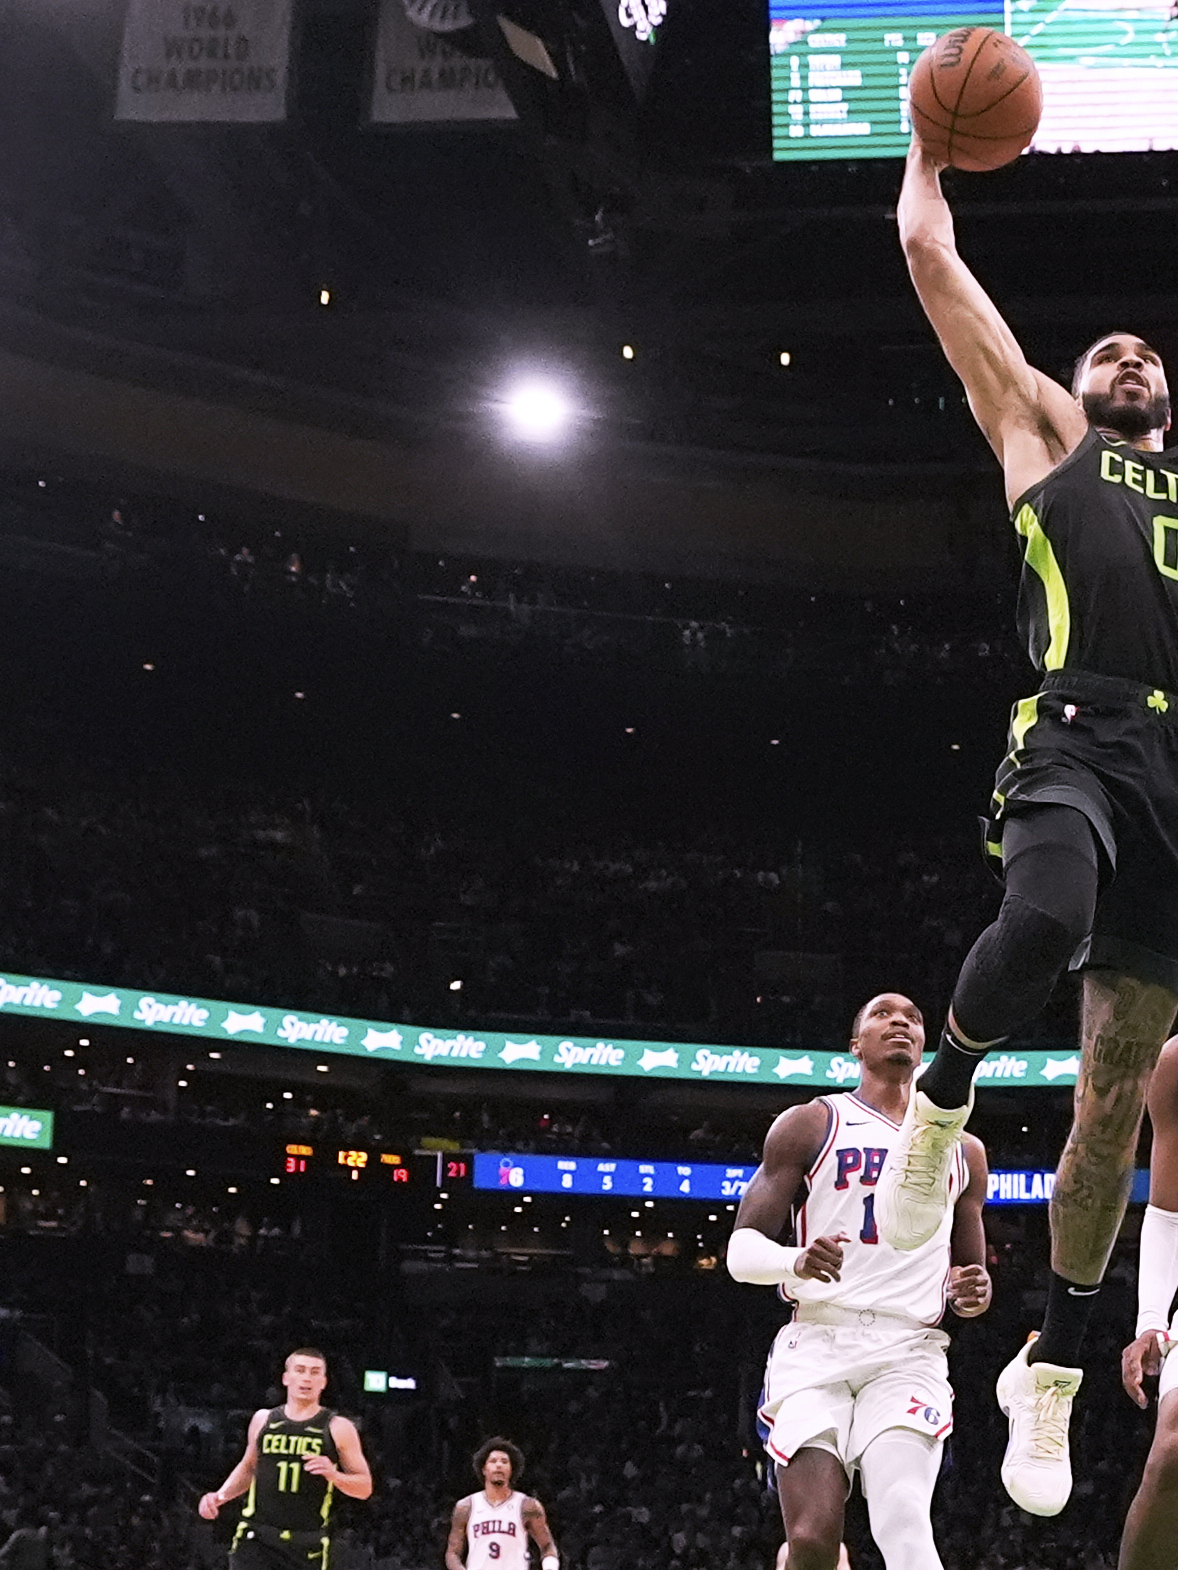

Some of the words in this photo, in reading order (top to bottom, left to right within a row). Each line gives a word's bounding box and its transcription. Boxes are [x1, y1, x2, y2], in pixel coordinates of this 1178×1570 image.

[164, 36, 249, 60] WORLD
[131, 67, 276, 93] CHAMPIONS
[386, 65, 499, 92] CHAMPIO
[0, 978, 62, 1009] prite
[133, 996, 210, 1026] Sprite
[277, 1015, 349, 1044] Sprite
[413, 1032, 487, 1061] Sprite
[553, 1041, 625, 1068] Sprite
[691, 1049, 761, 1076] Sprite
[973, 1055, 1028, 1083] prite
[286, 1157, 306, 1173] 31
[447, 1162, 466, 1177] 21
[602, 1175, 613, 1190] 5
[642, 1176, 653, 1192] 2
[679, 1179, 691, 1193] 4
[987, 1173, 1056, 1200] PHILAD
[860, 1193, 878, 1244] 1
[907, 1396, 941, 1425] 76
[263, 1434, 323, 1455] CELTICS
[276, 1461, 301, 1493] 11
[473, 1520, 517, 1538] PHILA
[489, 1541, 500, 1559] 9
